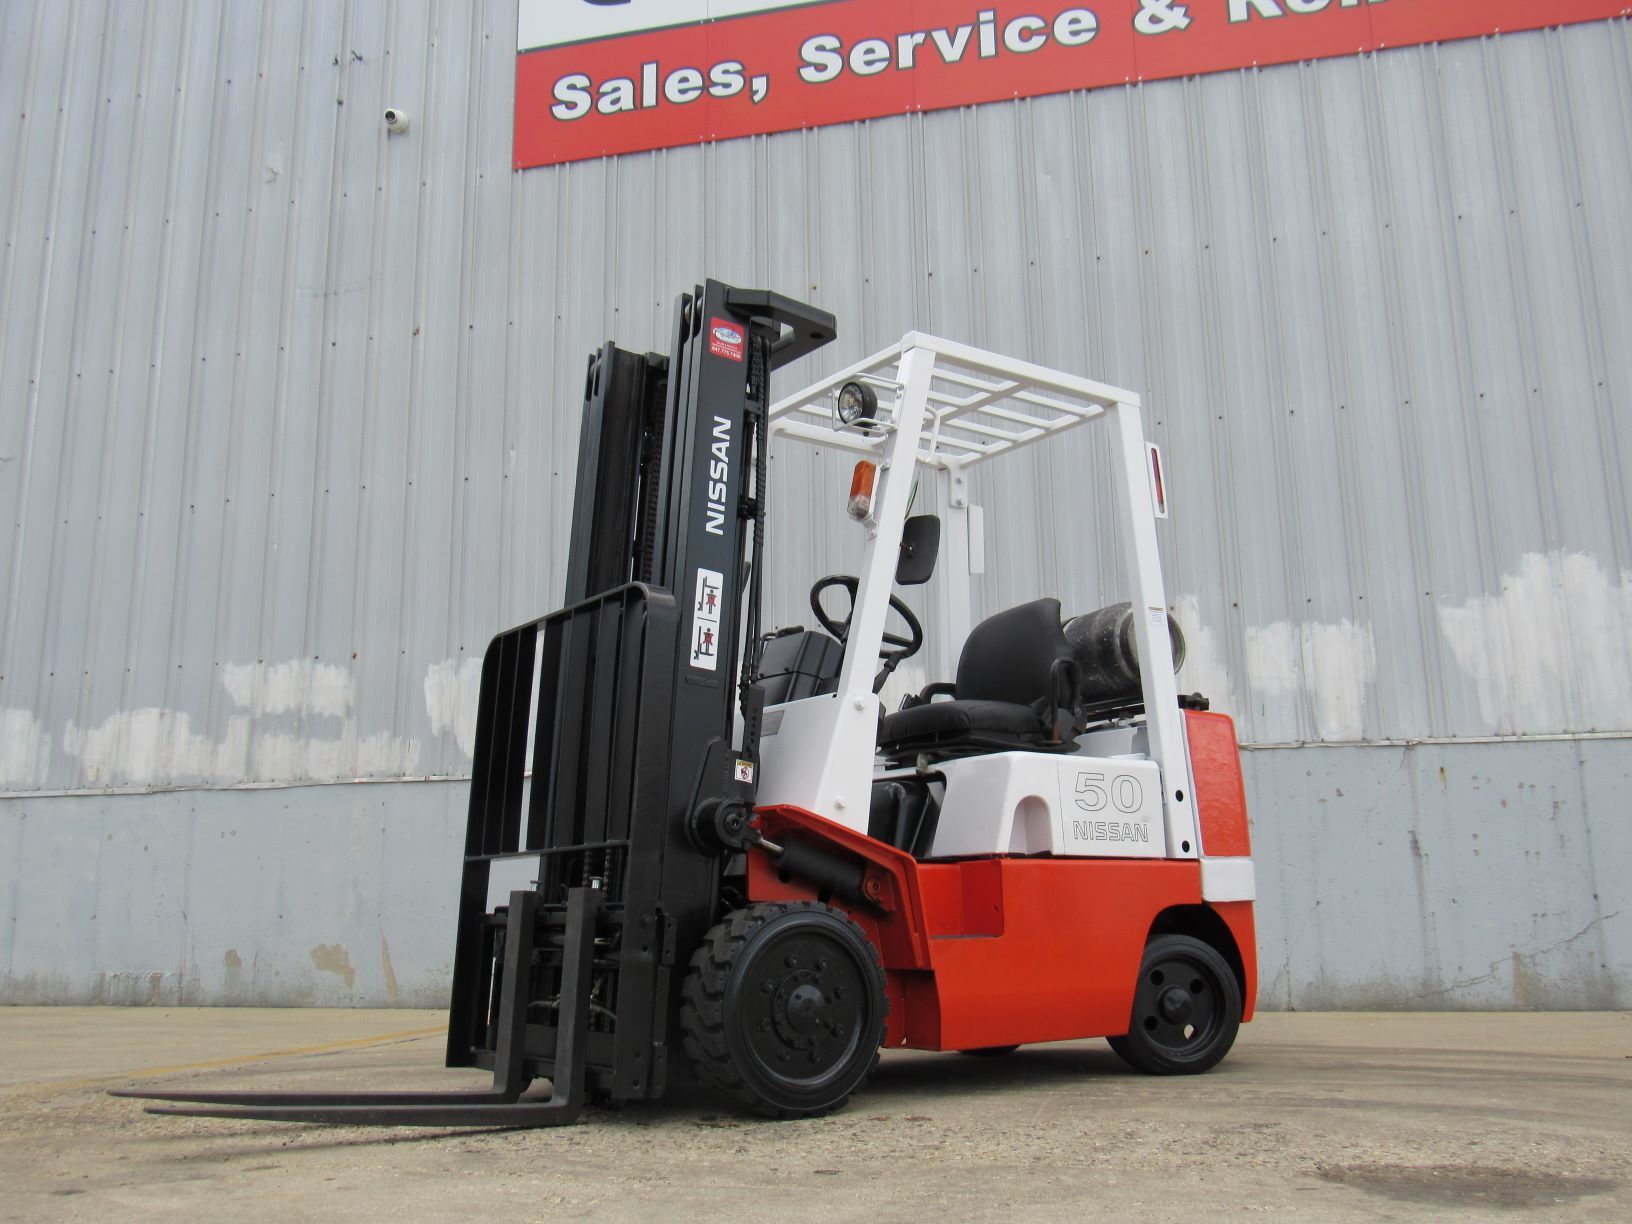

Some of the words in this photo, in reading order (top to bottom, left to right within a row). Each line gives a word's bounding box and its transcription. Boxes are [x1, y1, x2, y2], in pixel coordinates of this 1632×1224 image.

[550, 60, 768, 120] Sales,
[798, 8, 1099, 83] Service
[1132, 0, 1194, 35] &
[705, 415, 732, 535] NISSAN
[1072, 820, 1149, 843] NISSAN
[1074, 772, 1144, 814] 50
